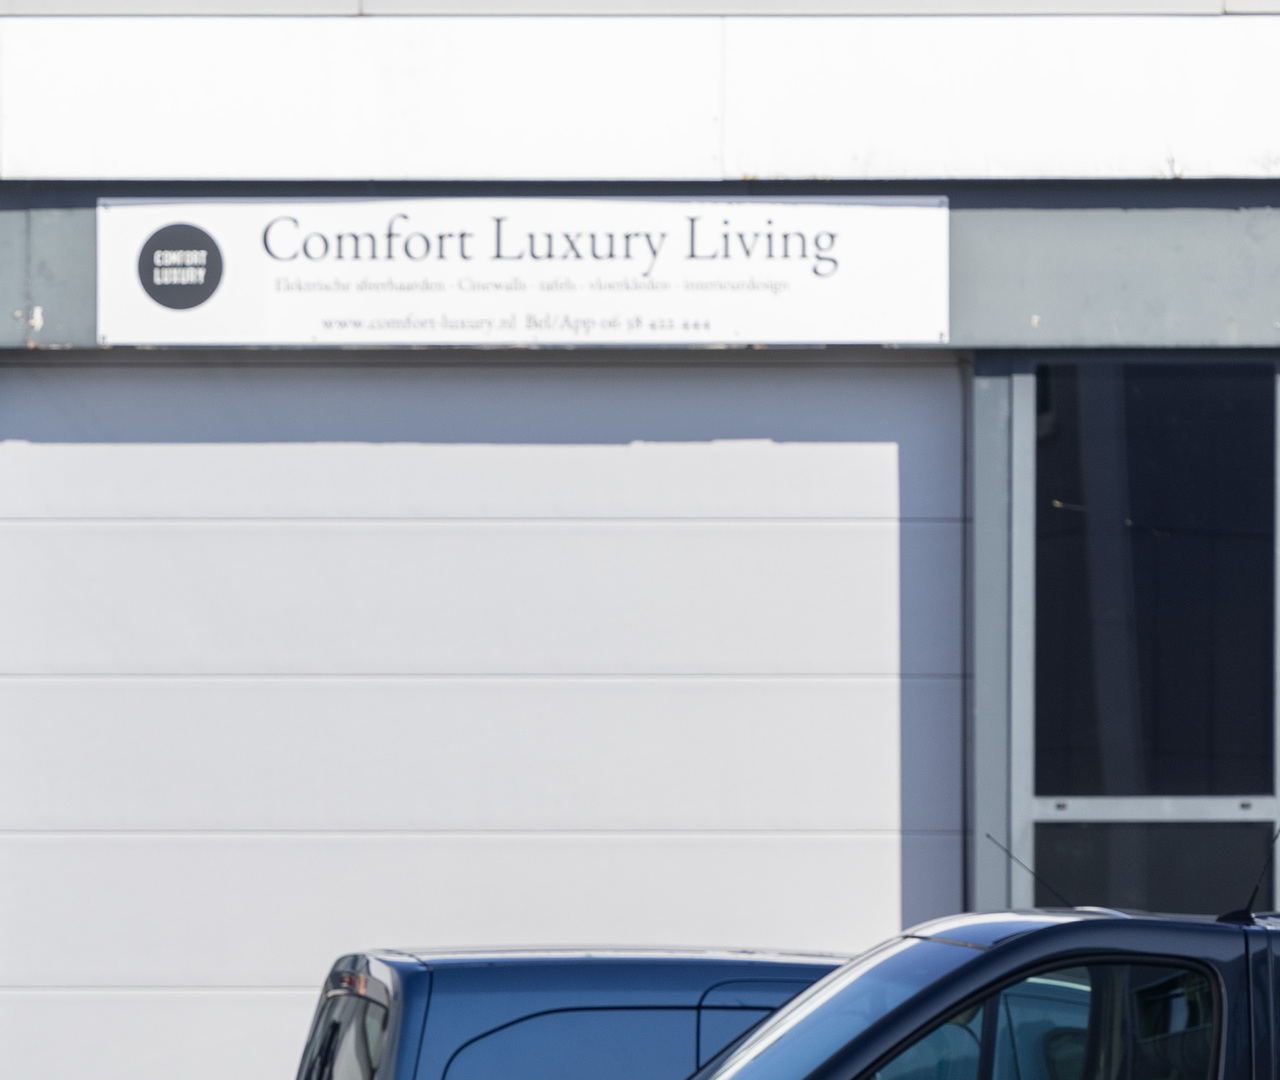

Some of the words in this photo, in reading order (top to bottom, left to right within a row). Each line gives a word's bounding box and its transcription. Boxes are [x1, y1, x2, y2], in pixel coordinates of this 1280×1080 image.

[262, 213, 474, 262] Comfort
[491, 215, 668, 277] Luxury
[686, 215, 839, 278] Living
[153, 249, 208, 267] COMFORT
[153, 266, 206, 285] LUXURY
